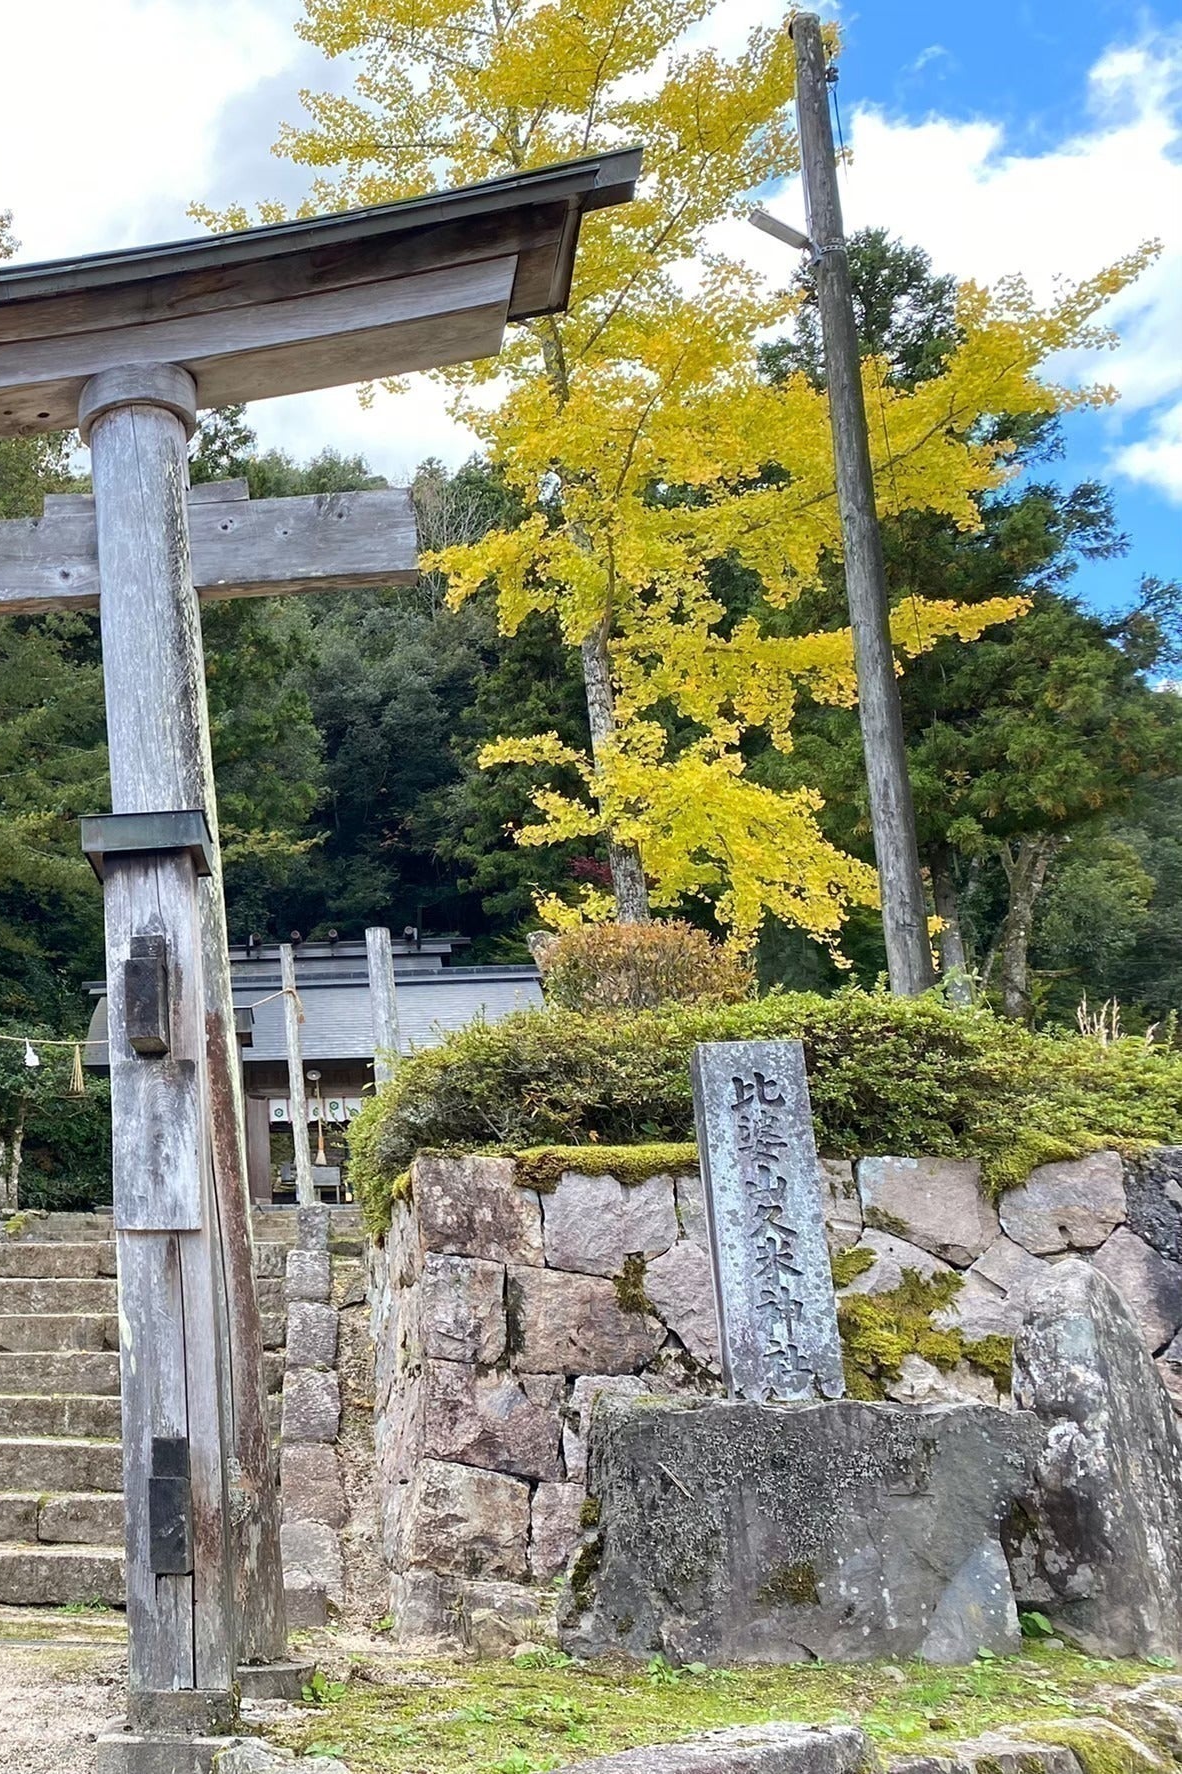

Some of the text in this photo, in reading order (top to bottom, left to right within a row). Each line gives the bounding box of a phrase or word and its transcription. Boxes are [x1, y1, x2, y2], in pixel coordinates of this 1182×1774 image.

[729, 1071, 815, 1376] 比婆山久米神社
